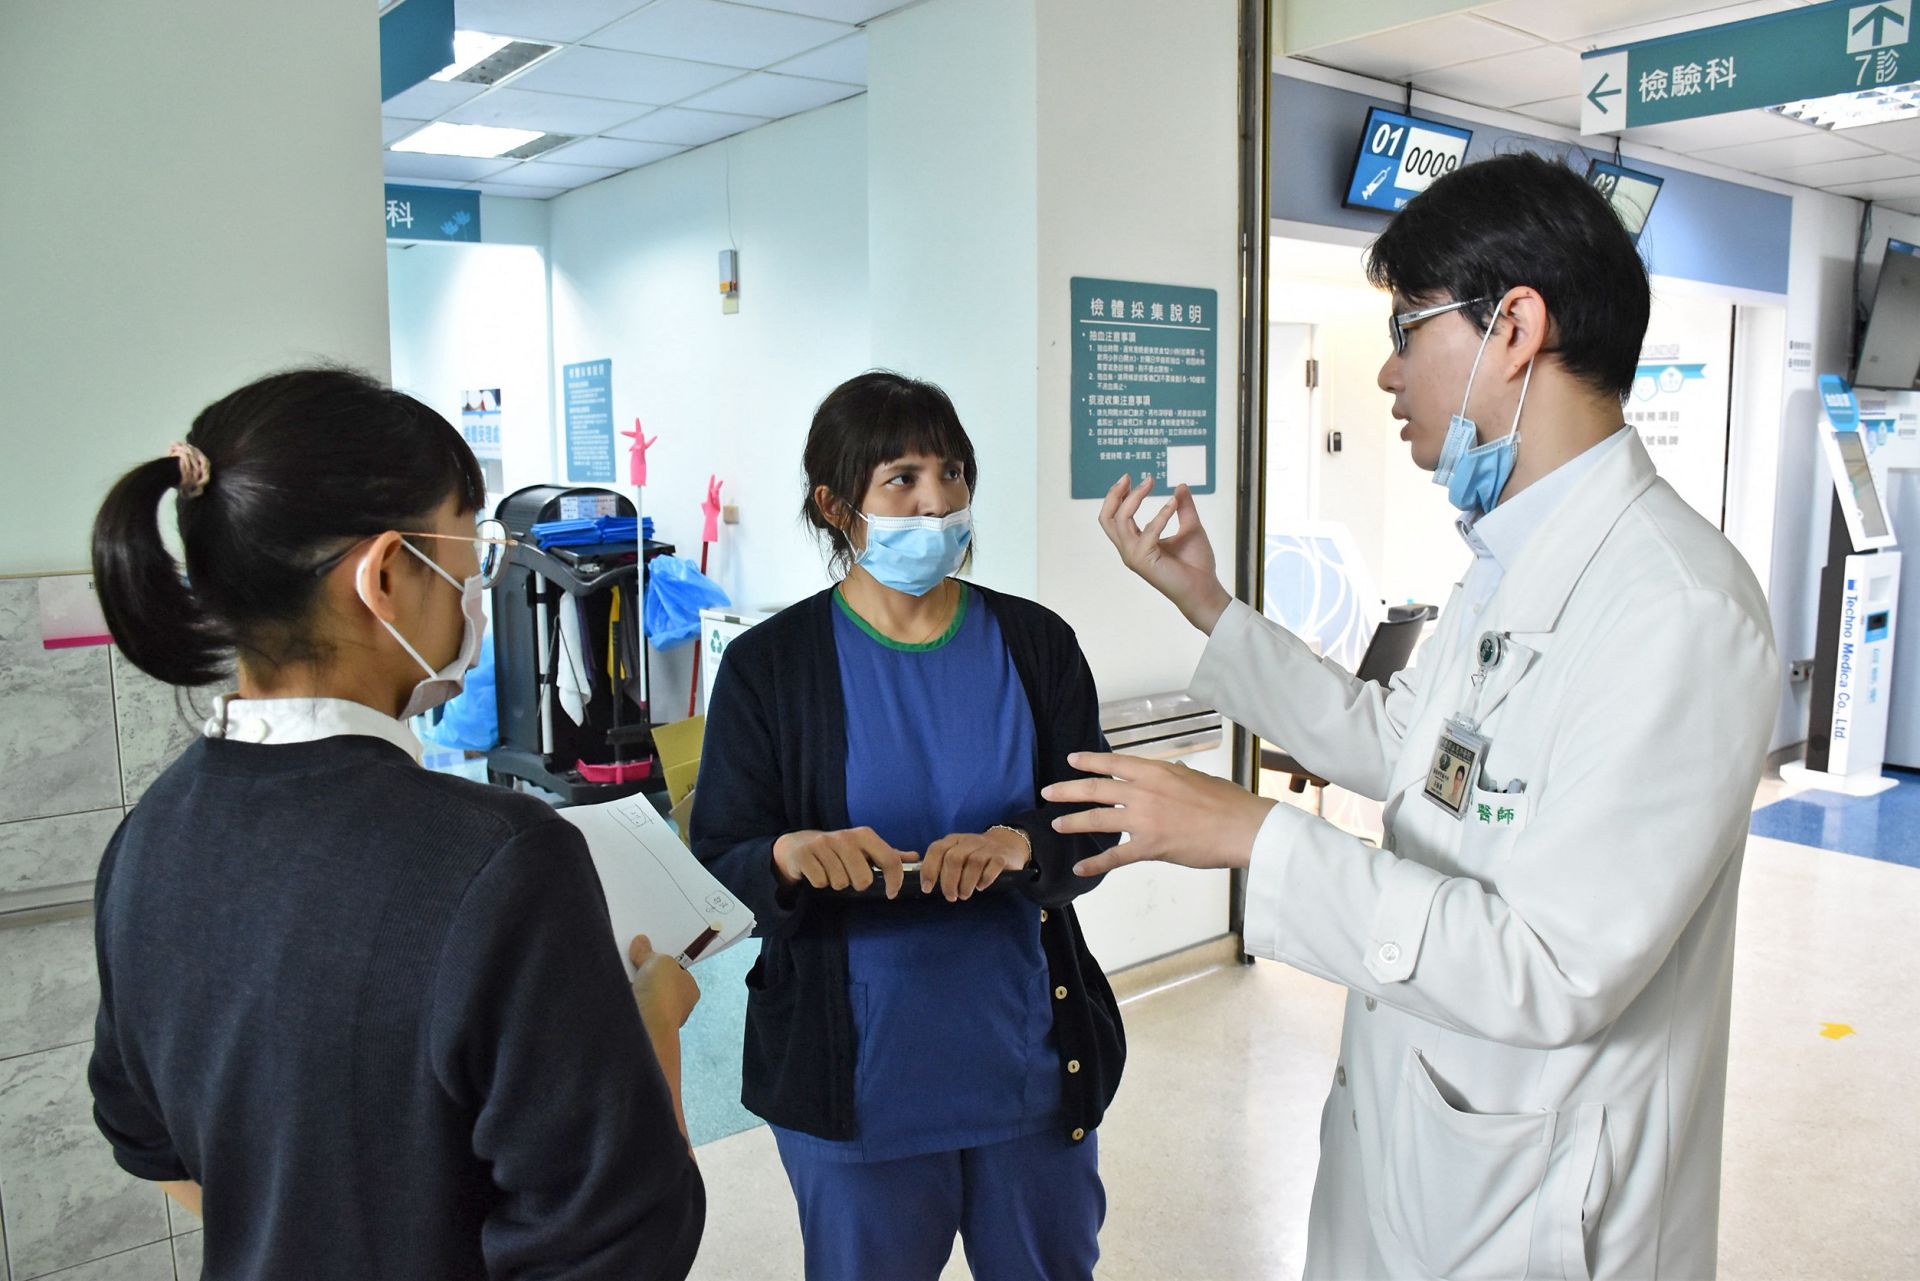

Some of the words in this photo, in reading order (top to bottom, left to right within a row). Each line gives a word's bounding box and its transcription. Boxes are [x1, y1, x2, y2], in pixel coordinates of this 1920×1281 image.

[1638, 56, 1737, 103] 檢驗科
[1854, 49, 1900, 86] 7診
[1371, 123, 1404, 157] 01
[386, 200, 414, 229] 科
[1090, 298, 1202, 324] 檢體採集說明
[1843, 594, 1858, 638] Techno
[1839, 642, 1854, 688] Medica
[1477, 803, 1514, 825] 醫師
